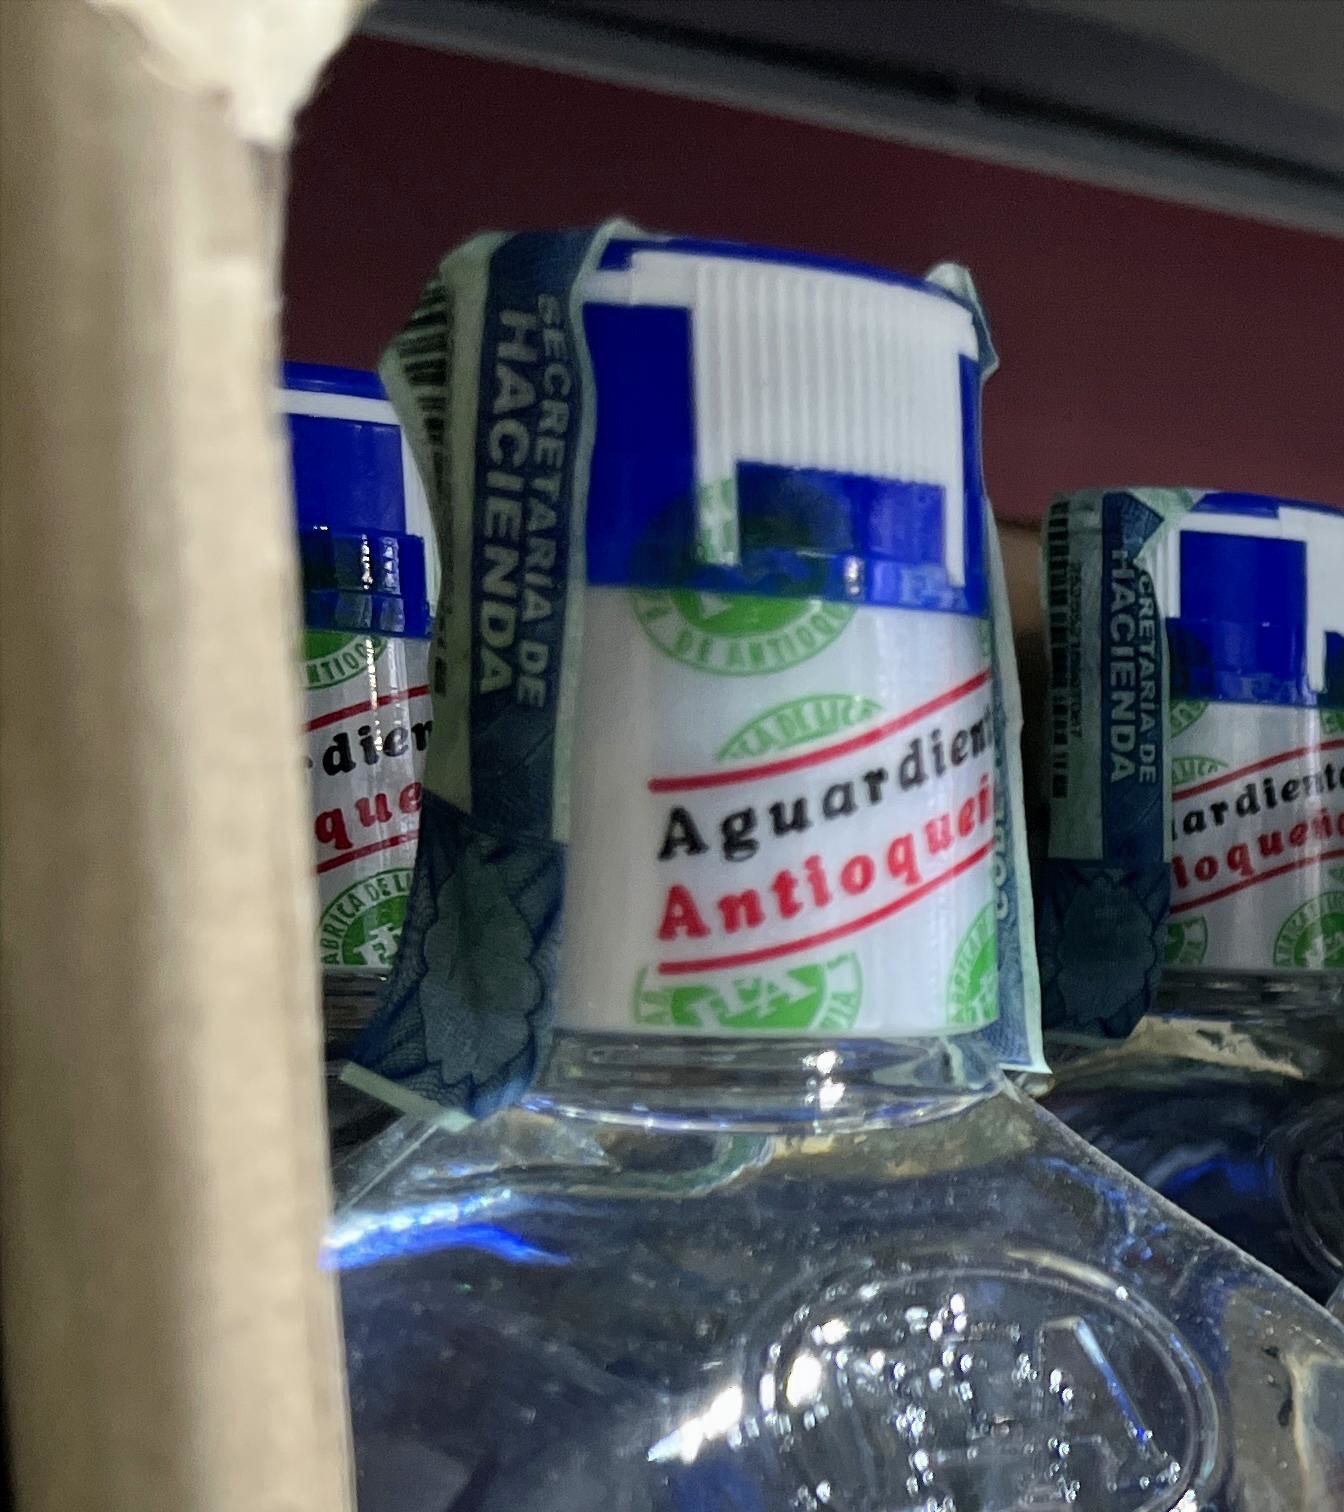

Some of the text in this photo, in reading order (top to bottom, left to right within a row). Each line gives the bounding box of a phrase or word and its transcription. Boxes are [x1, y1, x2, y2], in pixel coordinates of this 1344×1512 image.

[477, 308, 539, 697] HACIENDA
[515, 638, 551, 708] DE
[1108, 549, 1138, 783] HACIENDA
[1136, 574, 1158, 785] CRETARÍA DE
